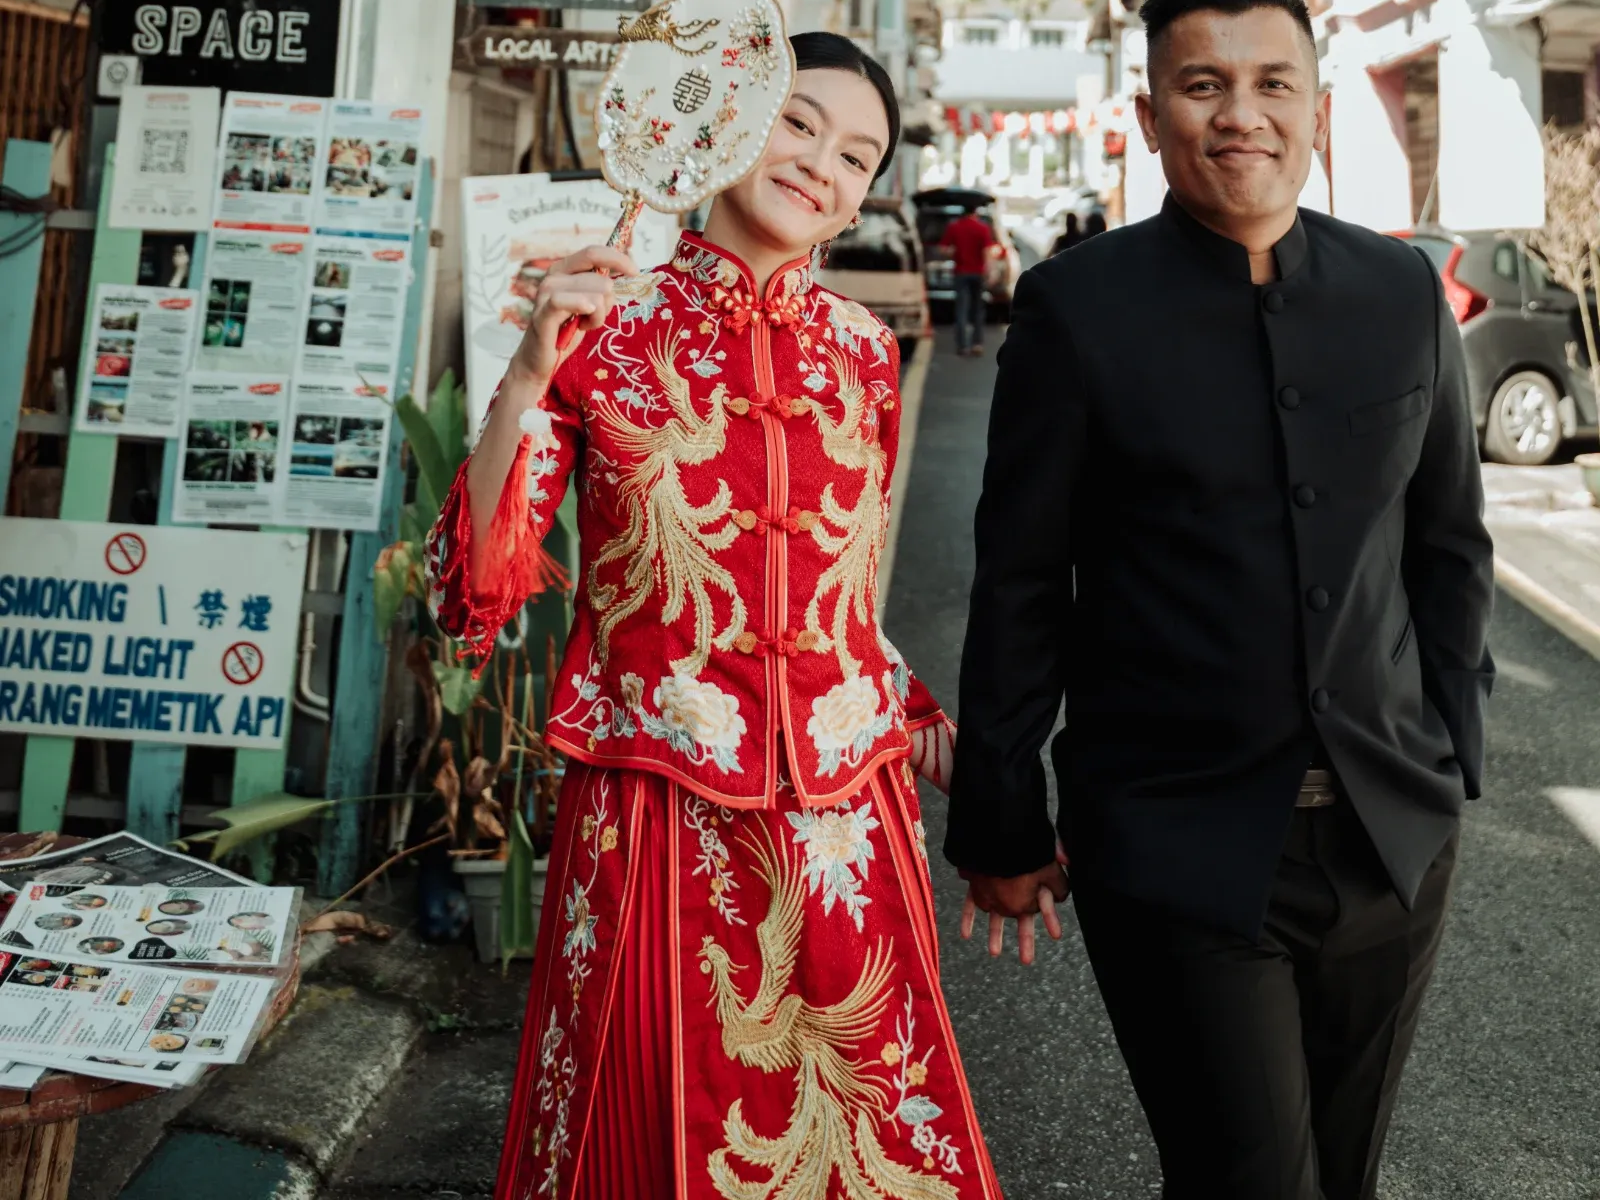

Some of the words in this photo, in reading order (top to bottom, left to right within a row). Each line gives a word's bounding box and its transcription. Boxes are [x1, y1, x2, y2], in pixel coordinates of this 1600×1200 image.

[132, 4, 310, 64] SPACE
[485, 36, 558, 61] LOCAL
[0, 574, 129, 623] SMOKING
[103, 634, 195, 681] LIGHT
[85, 686, 226, 735] MEMETIK
[232, 695, 286, 738] API
